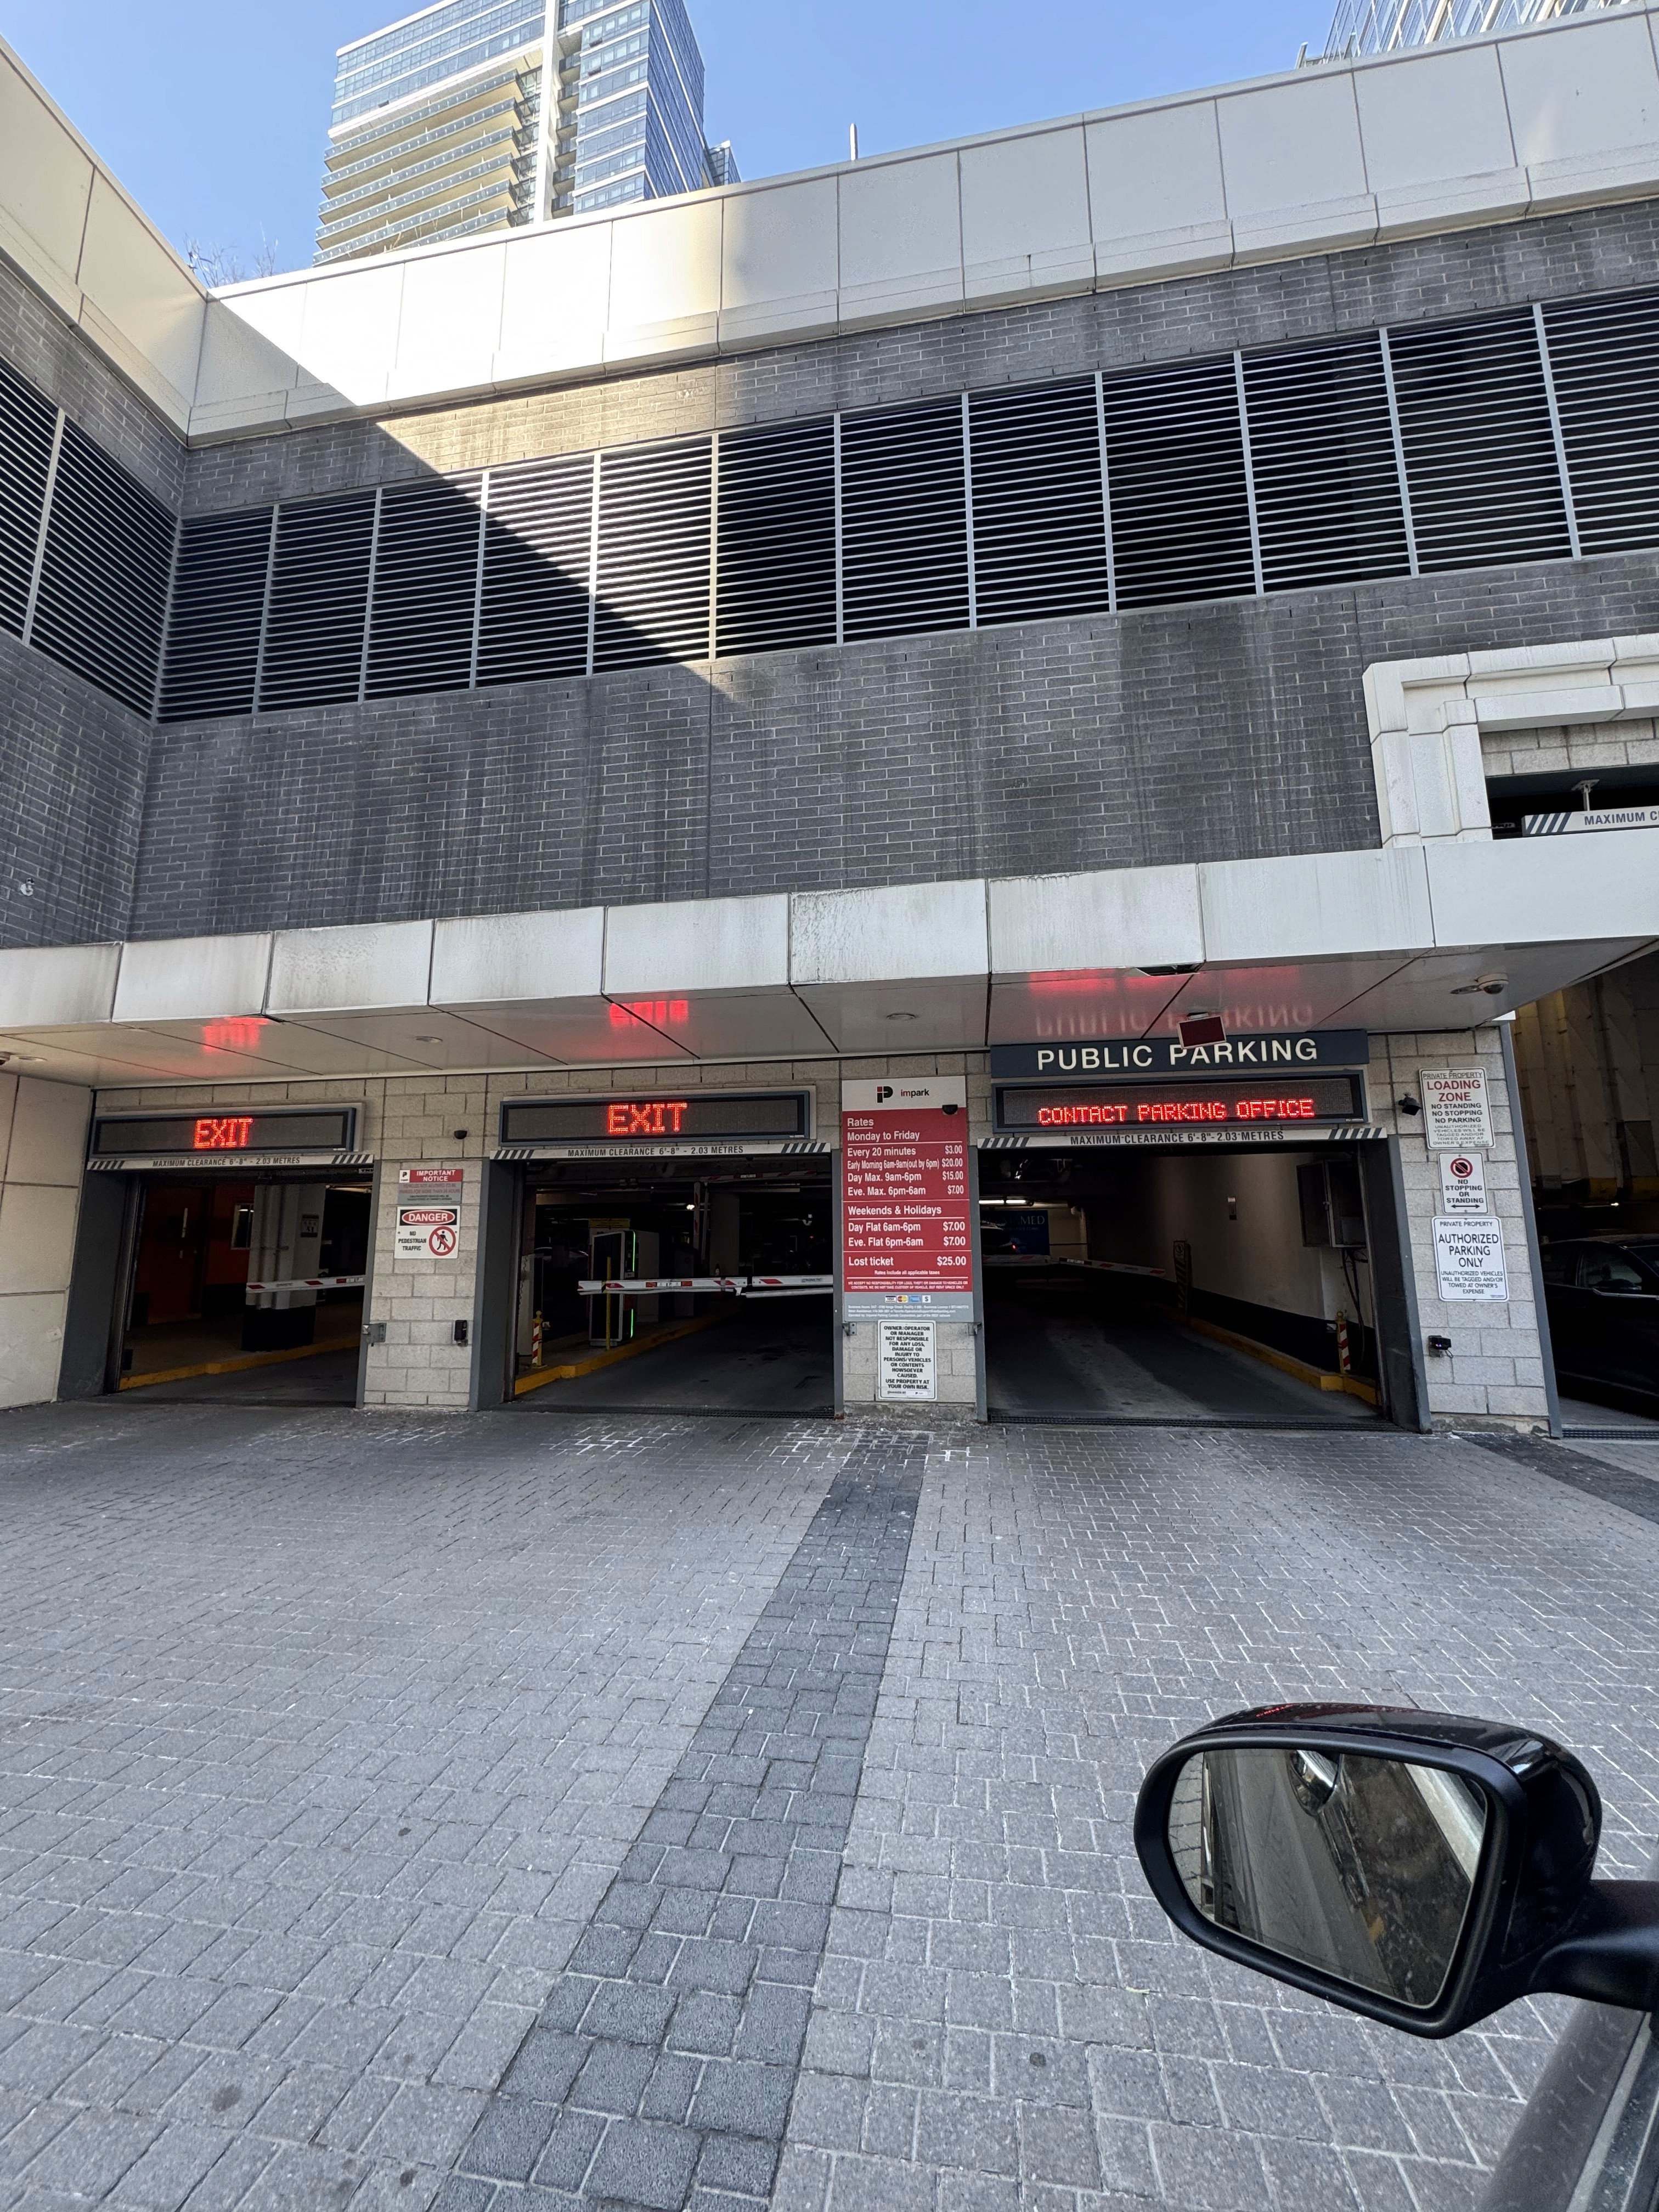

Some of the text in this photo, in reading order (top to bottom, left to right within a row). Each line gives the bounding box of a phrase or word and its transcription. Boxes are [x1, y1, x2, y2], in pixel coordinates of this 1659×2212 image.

[1584, 811, 1659, 826] MAXIMUM C
[1037, 1038, 1318, 1071] PUBLIC PARKING
[1427, 1080, 1481, 1090] LOADING
[900, 1088, 930, 1098] impark
[1438, 1092, 1471, 1102] ZONE
[1038, 1098, 1315, 1126] CONTACT PARKING OFFICE
[607, 1102, 688, 1134] EXIT
[847, 1118, 874, 1126] Rates
[194, 1117, 253, 1149] EXIT
[847, 1131, 920, 1142] Monday to Friday
[1070, 1135, 1121, 1145] MAXIMUM
[1125, 1133, 1184, 1143] CLEARANCE
[1217, 1132, 1238, 1142] 2.03
[1241, 1131, 1284, 1141] METRES
[568, 1148, 606, 1156] MAXIMUM
[609, 1148, 655, 1156] CLEARANCE
[847, 1145, 963, 1158] Every 20 minutes $3.00
[153, 1159, 185, 1167] MAXIMUM
[847, 1160, 861, 1171] Early
[861, 1159, 883, 1171] Morning
[918, 1159, 926, 1170] by
[926, 1158, 940, 1170] 6pm)
[941, 1158, 963, 1167] $20.00
[848, 1171, 963, 1184] Day Max. 9am-6pm $15.00
[848, 1185, 964, 1198] Eve. Max. 6pm-6am $7.00
[848, 1205, 942, 1216] Weekends & Holidays
[408, 1213, 448, 1221] DANGER
[848, 1221, 966, 1233] Day Flat 6am-6pm $7.00
[848, 1236, 966, 1248] Eve. Flat 6pm-6am $7.00
[1438, 1233, 1499, 1244] AUTHORIZED
[1449, 1245, 1491, 1255] PARKING
[848, 1255, 967, 1266] Lost ticket $25.00
[1458, 1257, 1483, 1267] ONLY
